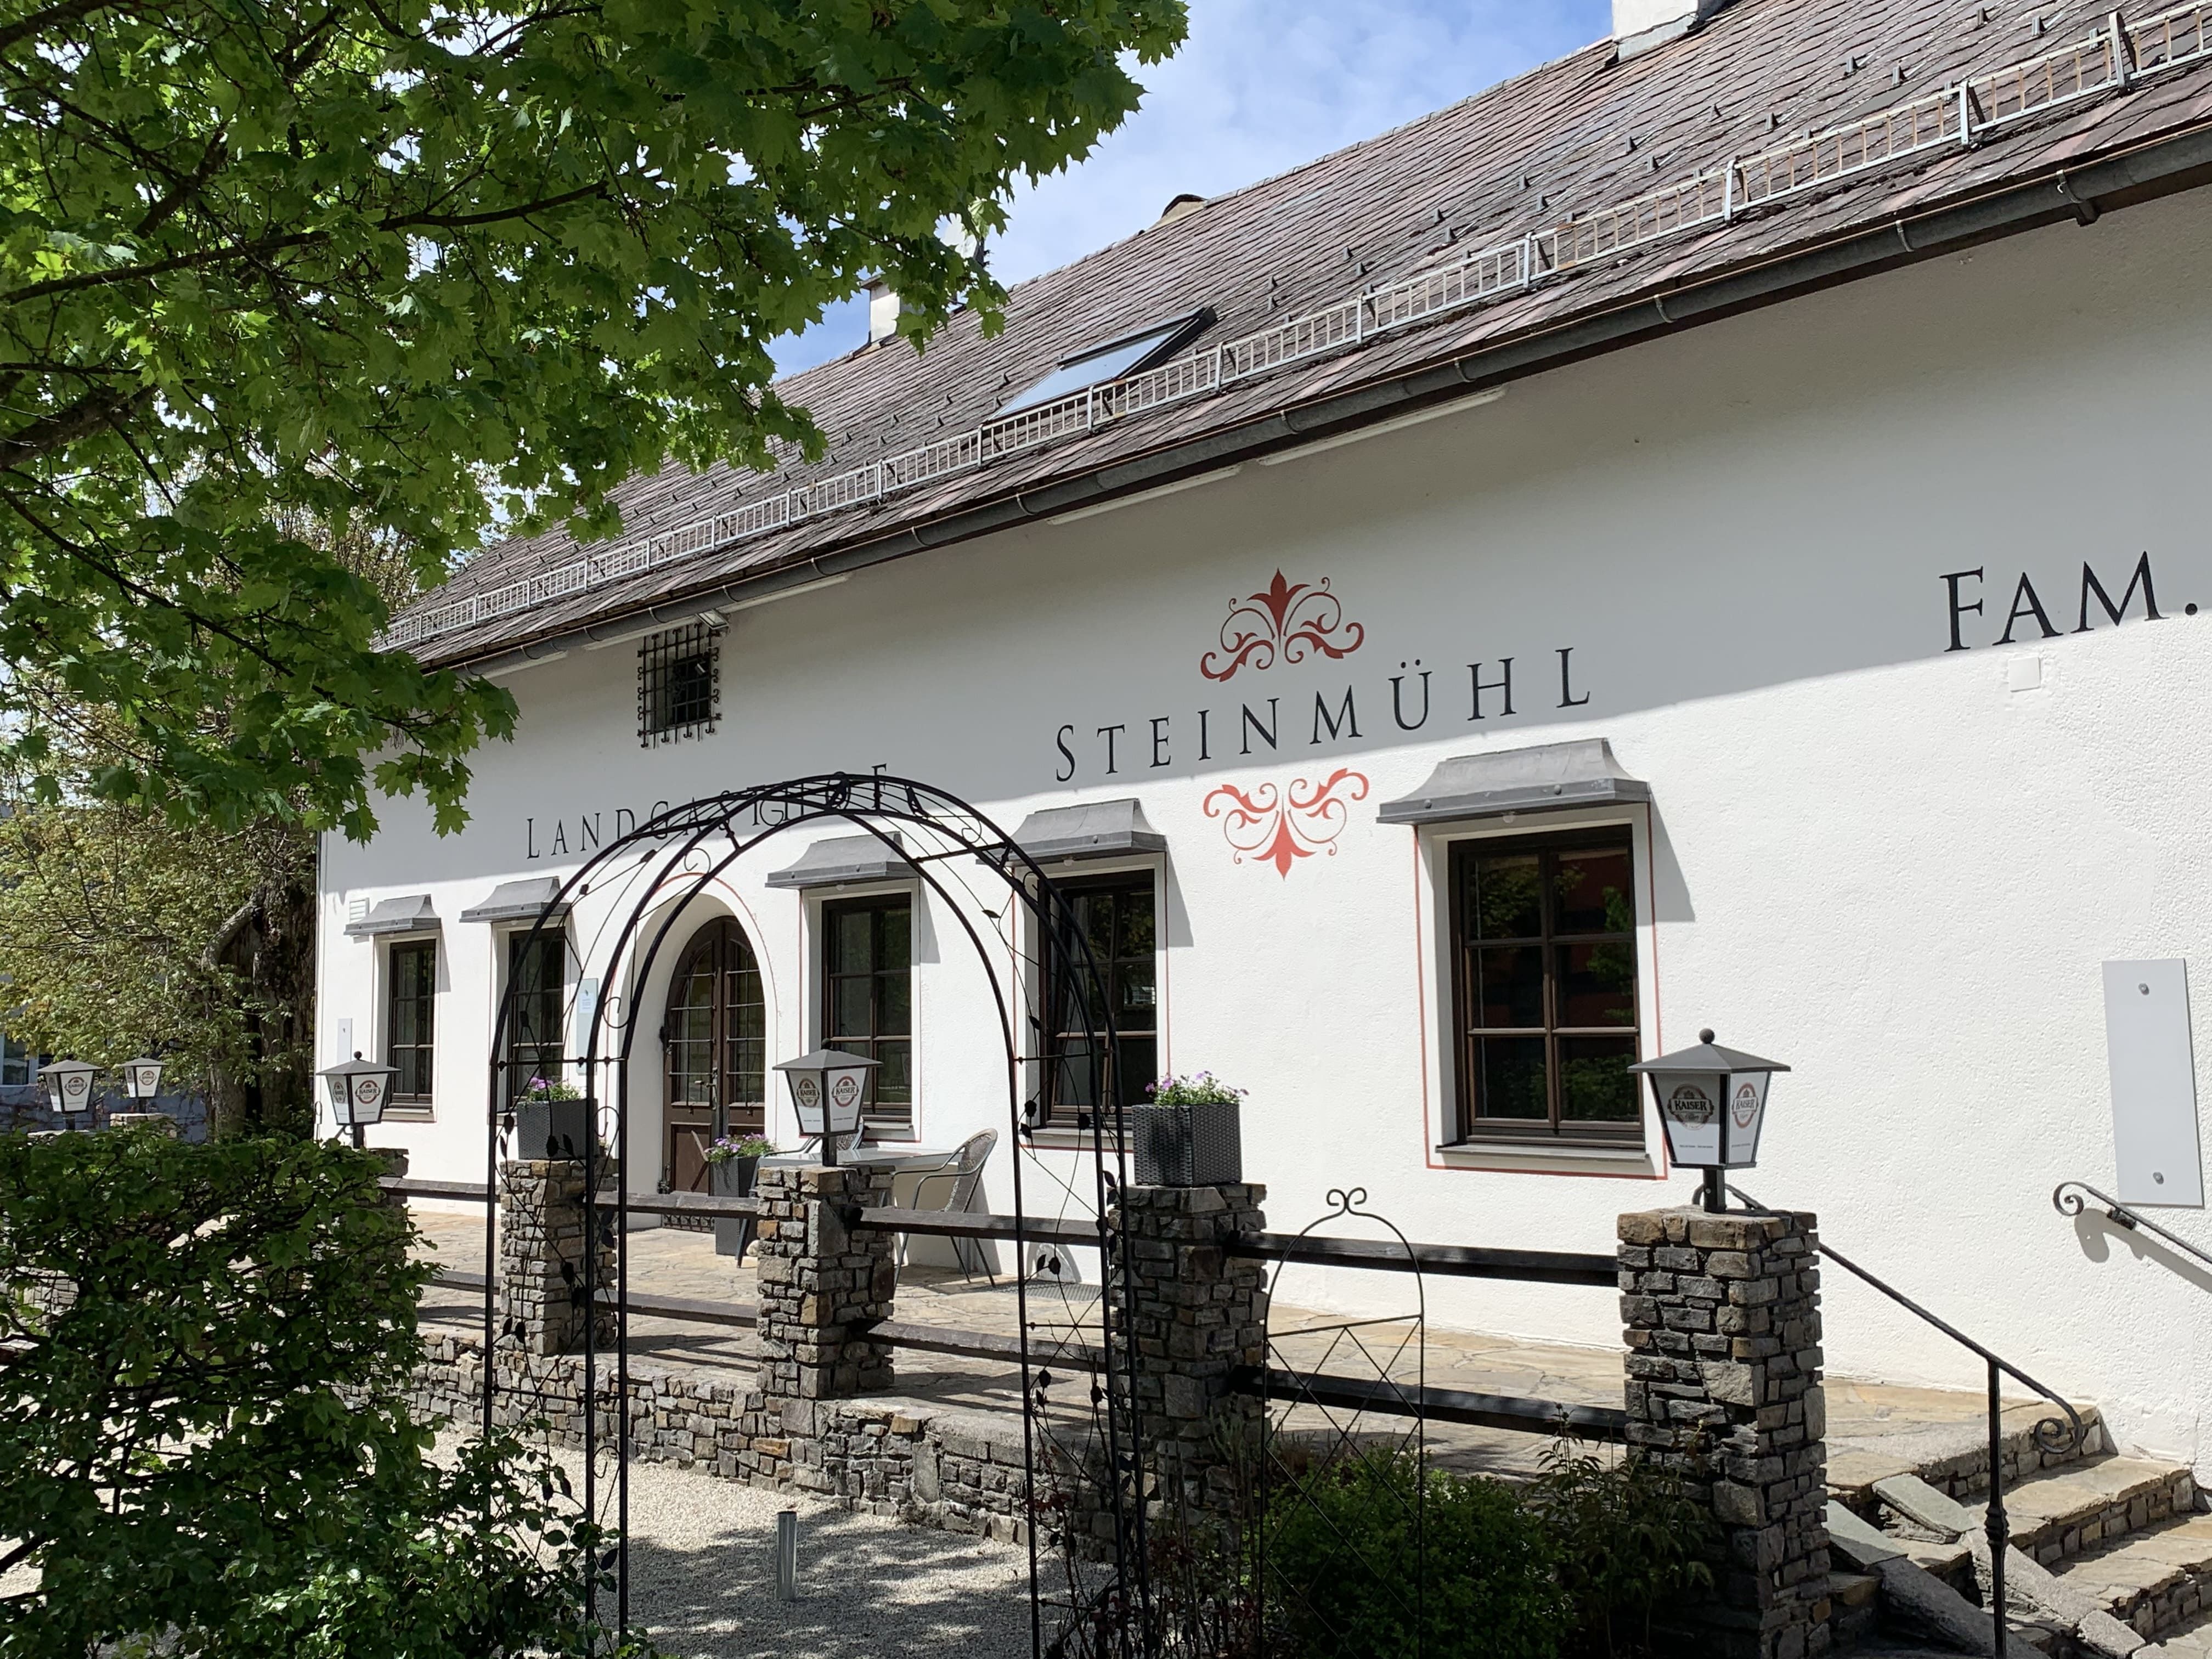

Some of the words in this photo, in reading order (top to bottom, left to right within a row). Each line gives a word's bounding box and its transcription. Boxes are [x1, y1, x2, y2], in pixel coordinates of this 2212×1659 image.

[1939, 550, 2198, 652] FAM.
[1056, 647, 1590, 782] STEINMÜHL
[836, 1086, 856, 1096] KAISER
[1674, 1099, 1707, 1111] KAISER
[1735, 1098, 1755, 1111] KAISER
